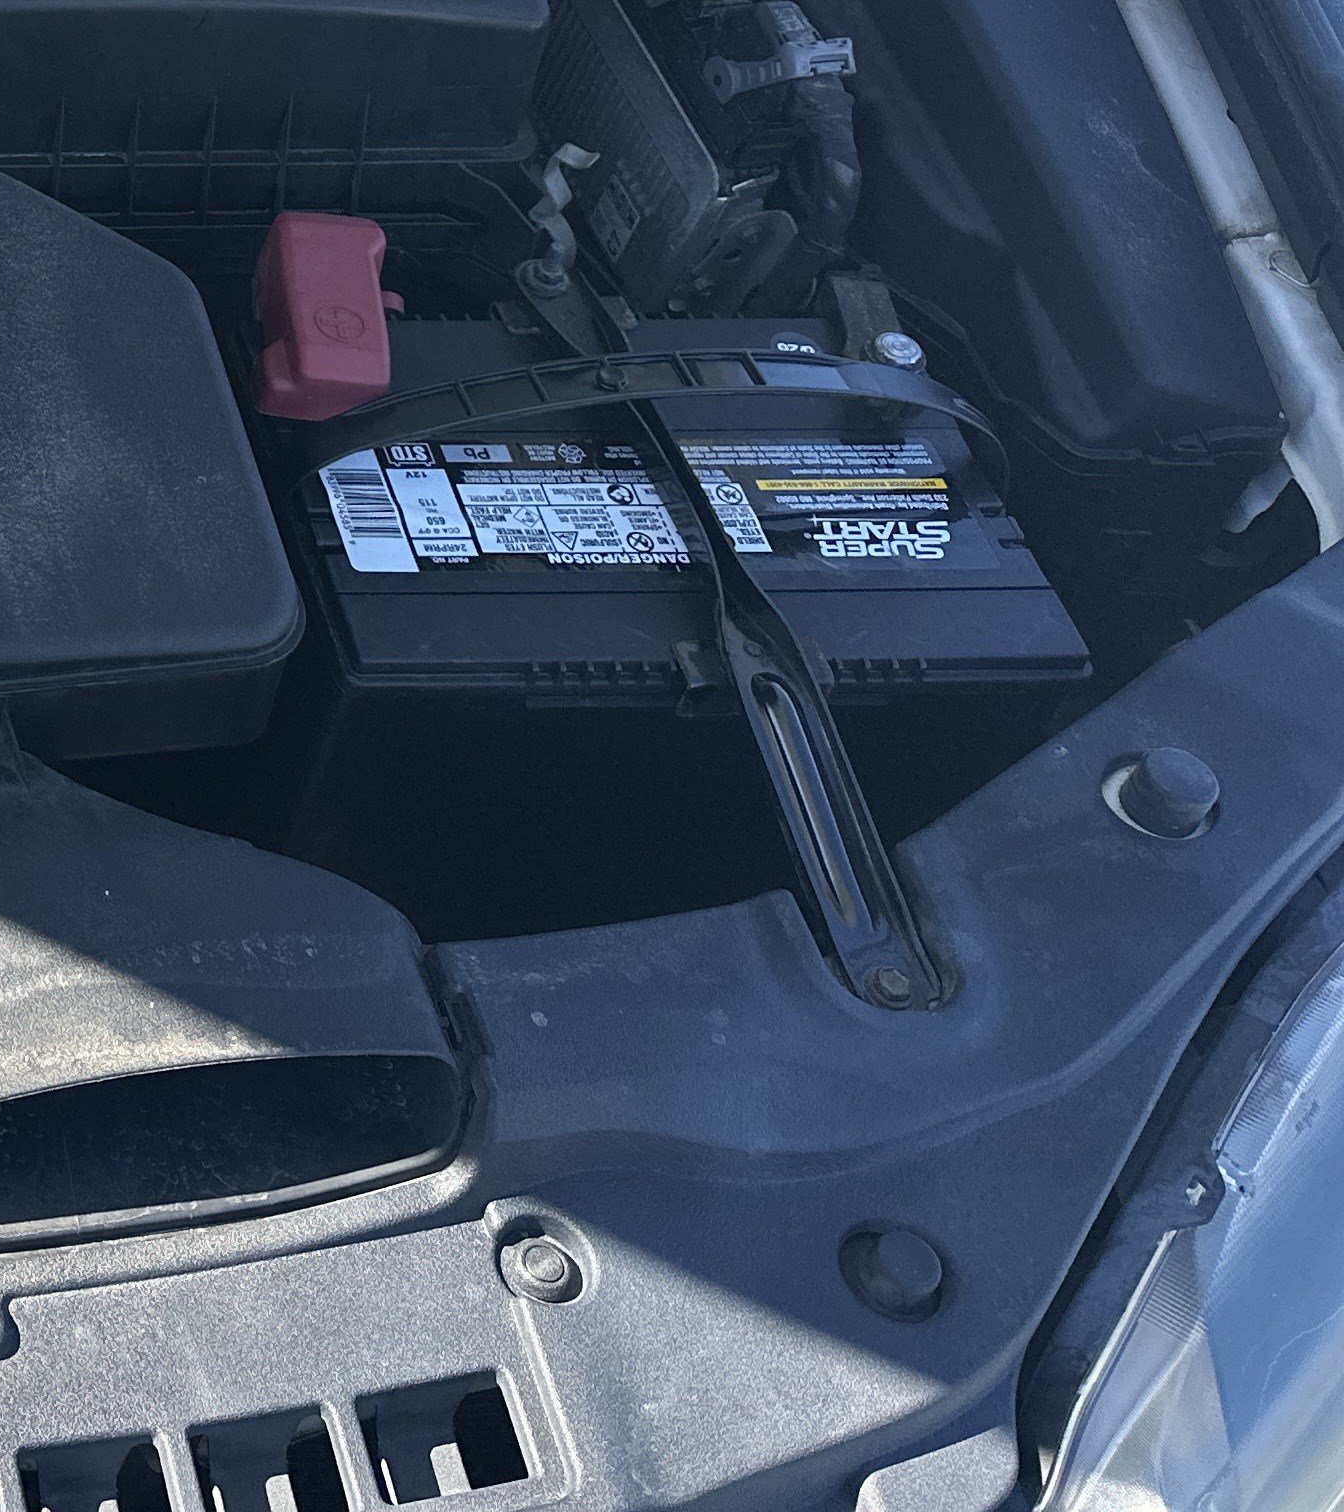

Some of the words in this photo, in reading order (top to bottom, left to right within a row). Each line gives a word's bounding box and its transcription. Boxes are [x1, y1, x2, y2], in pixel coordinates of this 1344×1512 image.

[391, 445, 428, 461] STD
[463, 447, 490, 459] Pb
[426, 516, 445, 525] 650
[812, 520, 951, 543] START
[818, 539, 945, 560] SUPER
[547, 552, 691, 564] DANGER/POISON
